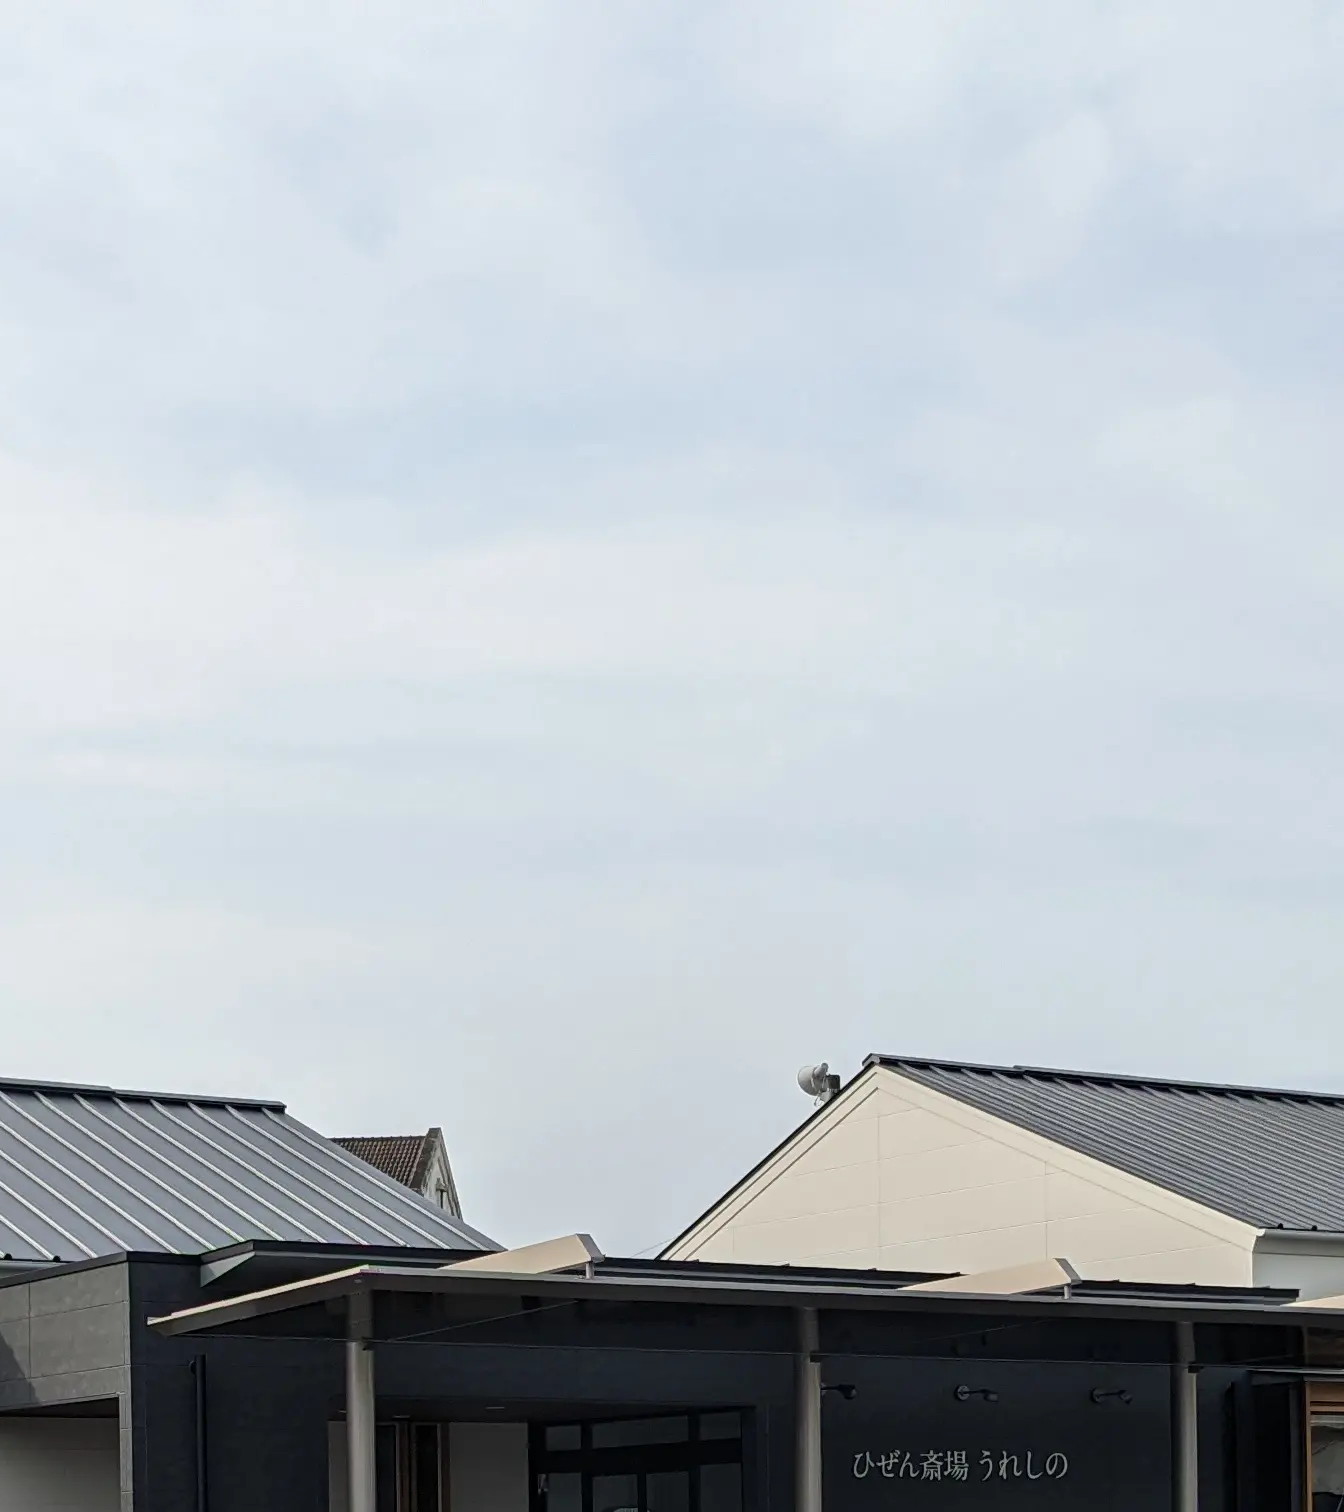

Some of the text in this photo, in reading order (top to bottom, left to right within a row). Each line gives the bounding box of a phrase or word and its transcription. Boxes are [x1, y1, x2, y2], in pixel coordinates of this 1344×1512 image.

[853, 1450, 1068, 1481] ひぜん斎場 うれしの
